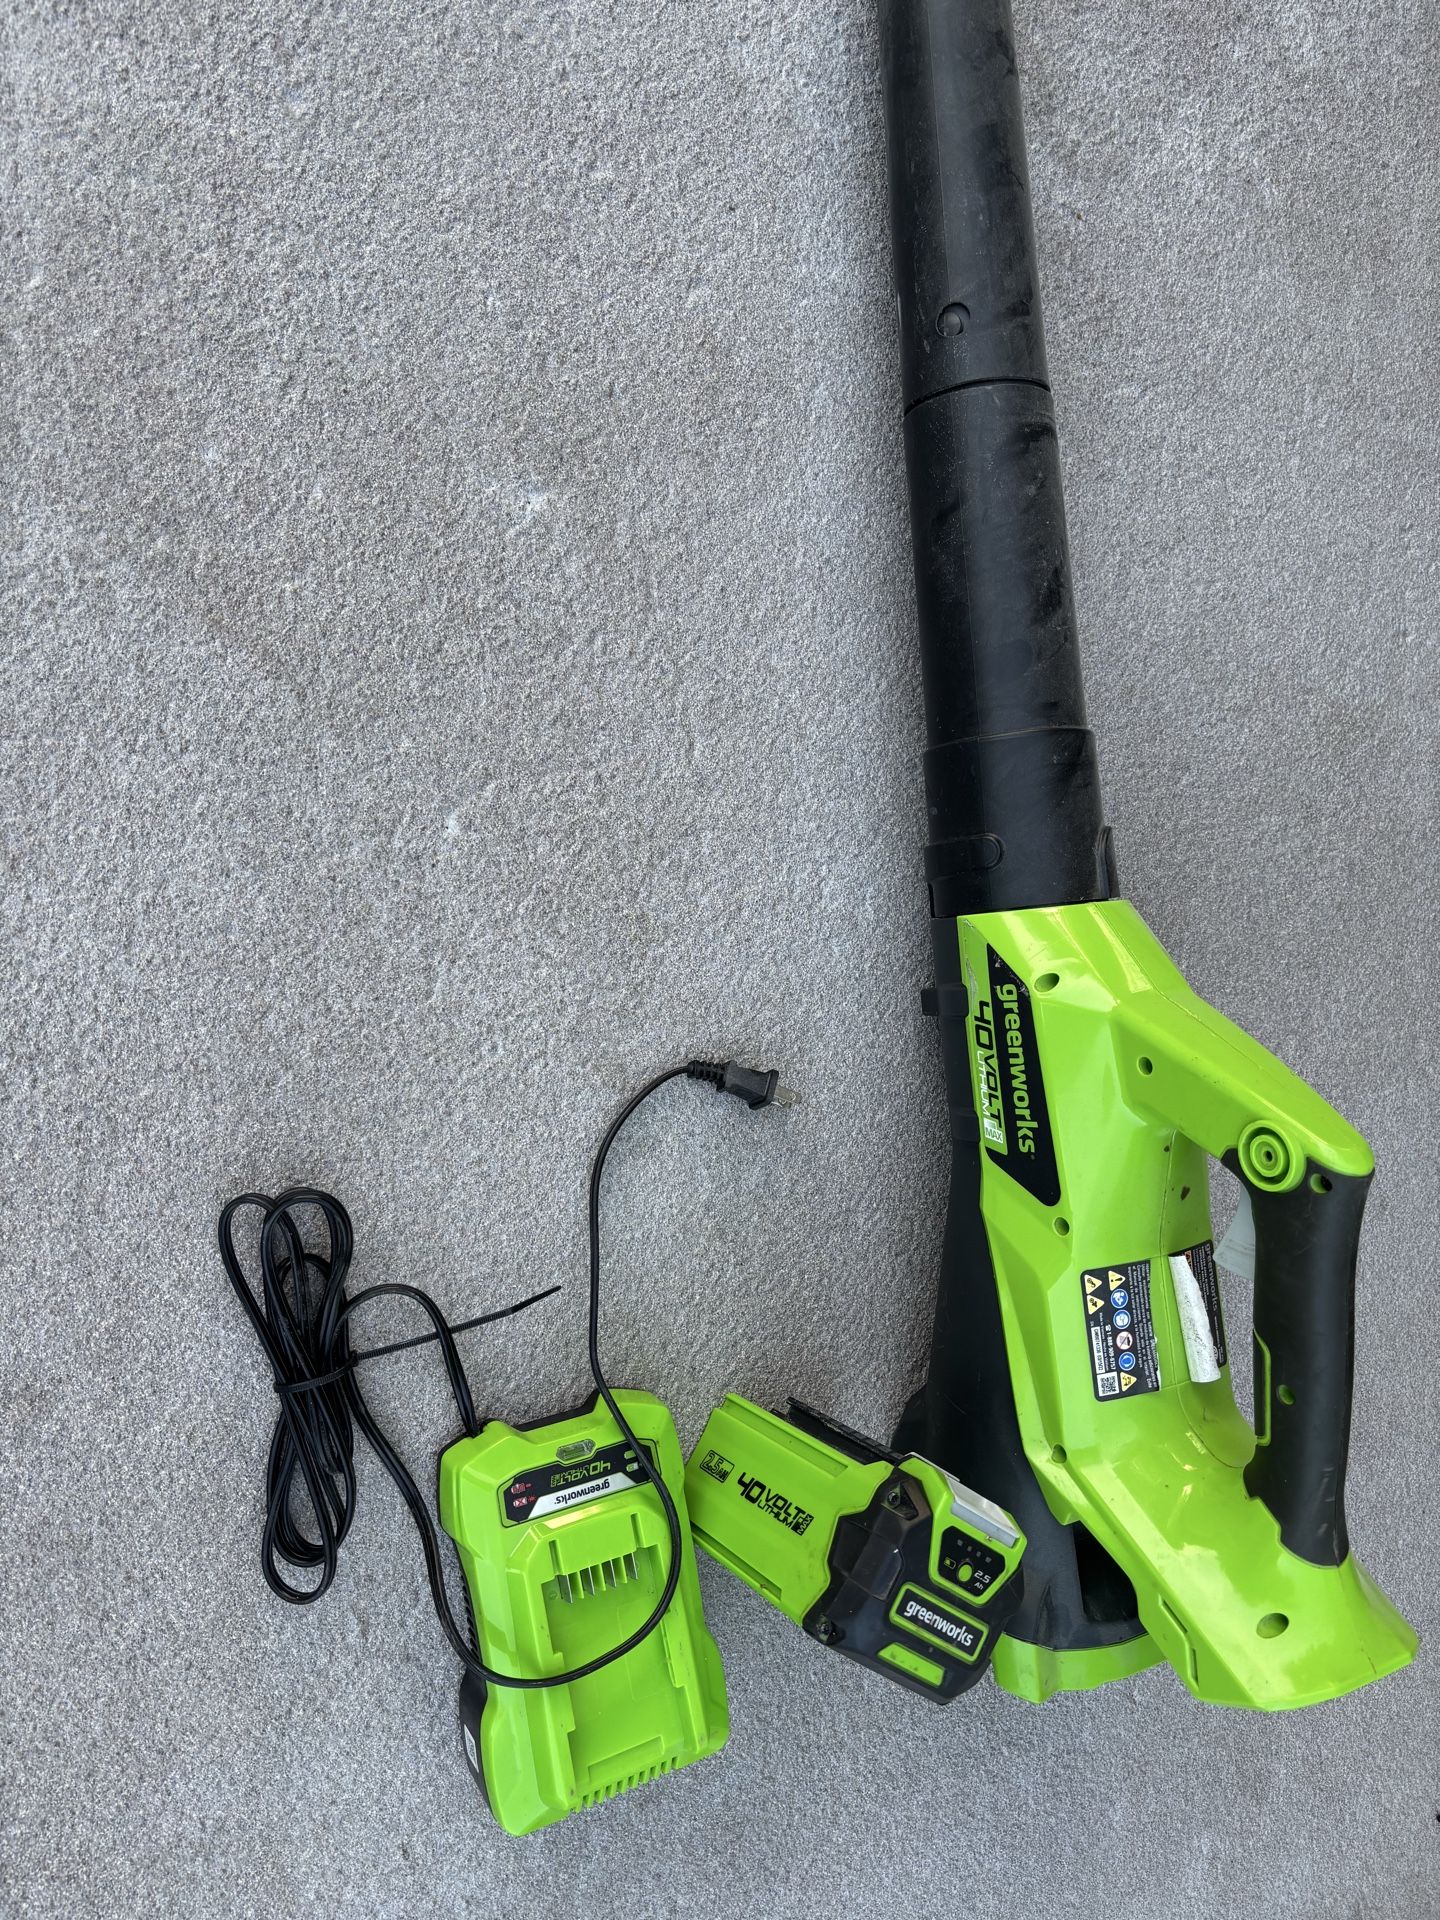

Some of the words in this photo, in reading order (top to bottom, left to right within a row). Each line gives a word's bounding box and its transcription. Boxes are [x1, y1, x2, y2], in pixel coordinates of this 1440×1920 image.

[974, 1000, 994, 1050] 40
[976, 1050, 990, 1117] LITHIUM
[993, 983, 1038, 1154] greenworks
[985, 1052, 1002, 1129] VOLT
[984, 1127, 1003, 1143] MAX
[1204, 1243, 1218, 1311] greenworks
[556, 1471, 589, 1485] VOLT
[589, 1459, 611, 1476] 40
[555, 1478, 610, 1505] greenworks
[737, 1472, 766, 1504] 40
[765, 1488, 806, 1521] VOLT
[797, 1514, 814, 1536] MAX
[757, 1500, 794, 1528] LITHIUM
[974, 1570, 991, 1584] 2.5
[974, 1582, 984, 1590] Ah
[903, 1599, 974, 1647] greenworks
